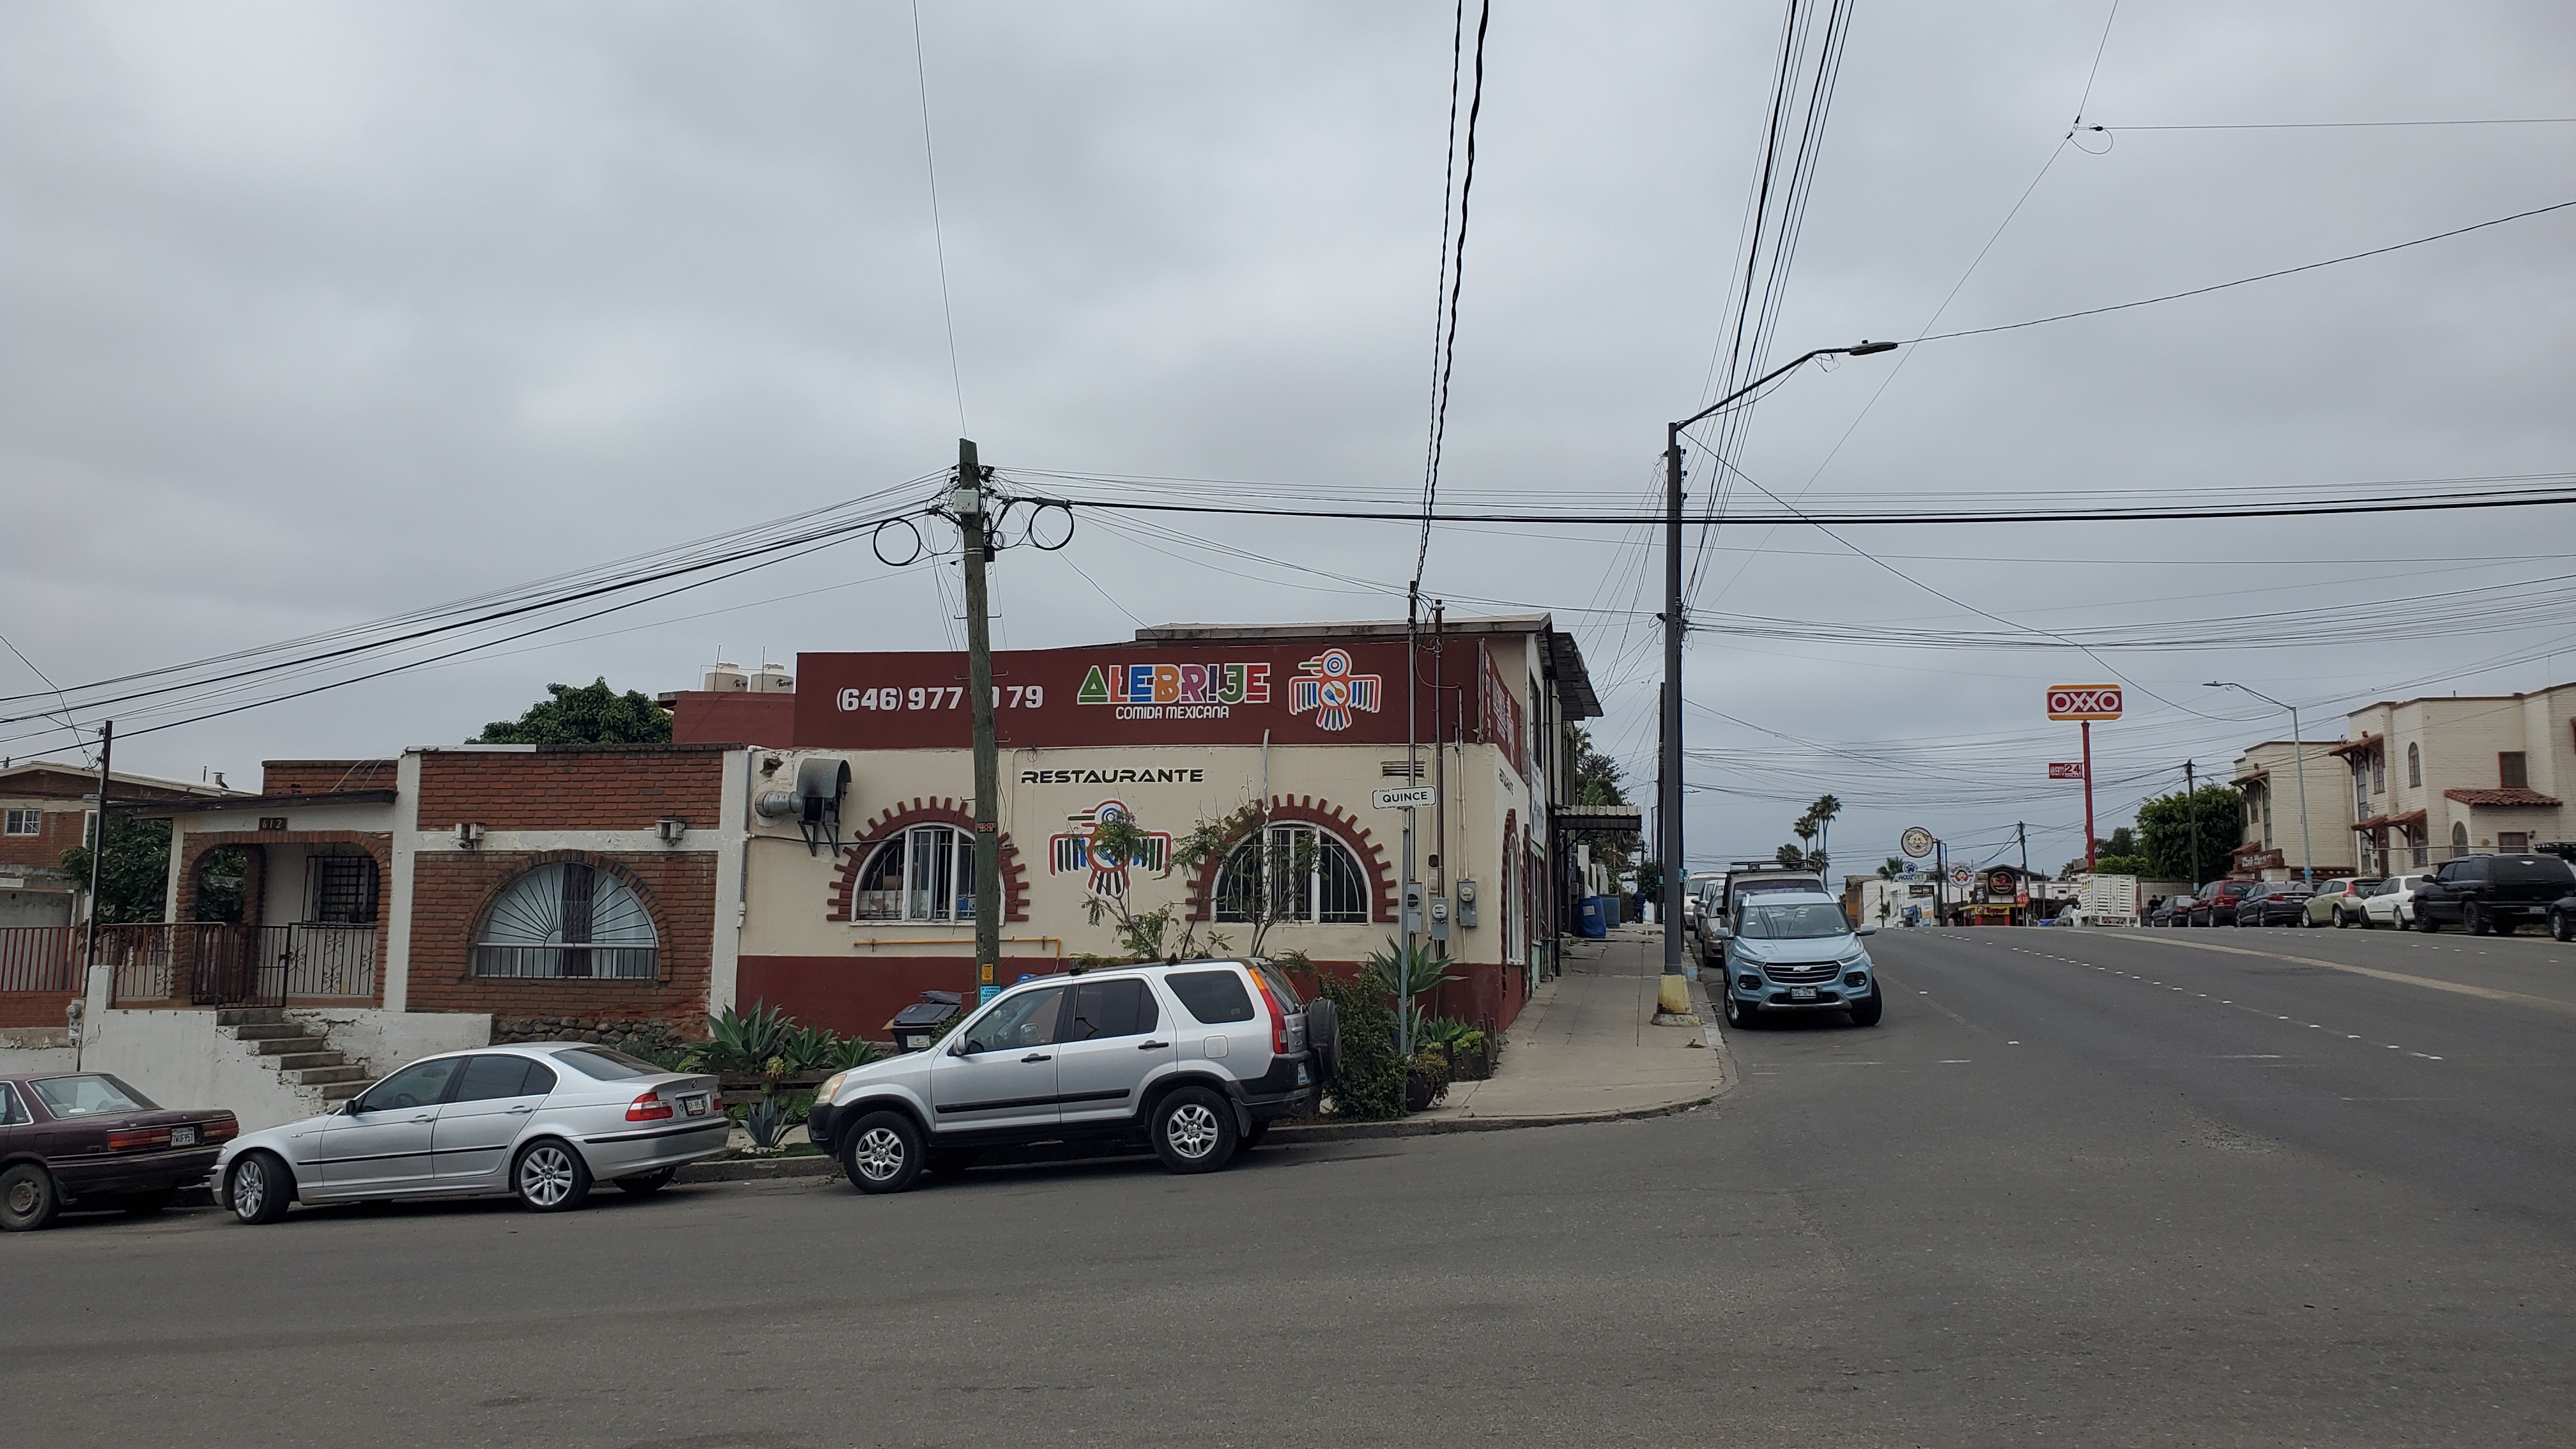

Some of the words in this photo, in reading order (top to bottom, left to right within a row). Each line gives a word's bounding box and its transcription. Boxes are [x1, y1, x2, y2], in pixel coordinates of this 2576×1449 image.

[1077, 663, 1270, 705] ALEBRIJE
[836, 686, 903, 712] (646)
[908, 687, 963, 710] 977
[1006, 686, 1043, 709] 79
[2051, 692, 2119, 712] OXXO
[1116, 706, 1162, 719] COMIDA
[1165, 705, 1229, 719] MEXICANA
[2065, 764, 2080, 773] 24
[1021, 769, 1204, 783] RESTAURANTE
[1383, 791, 1428, 802] QUINCE
[263, 819, 282, 829] 612
